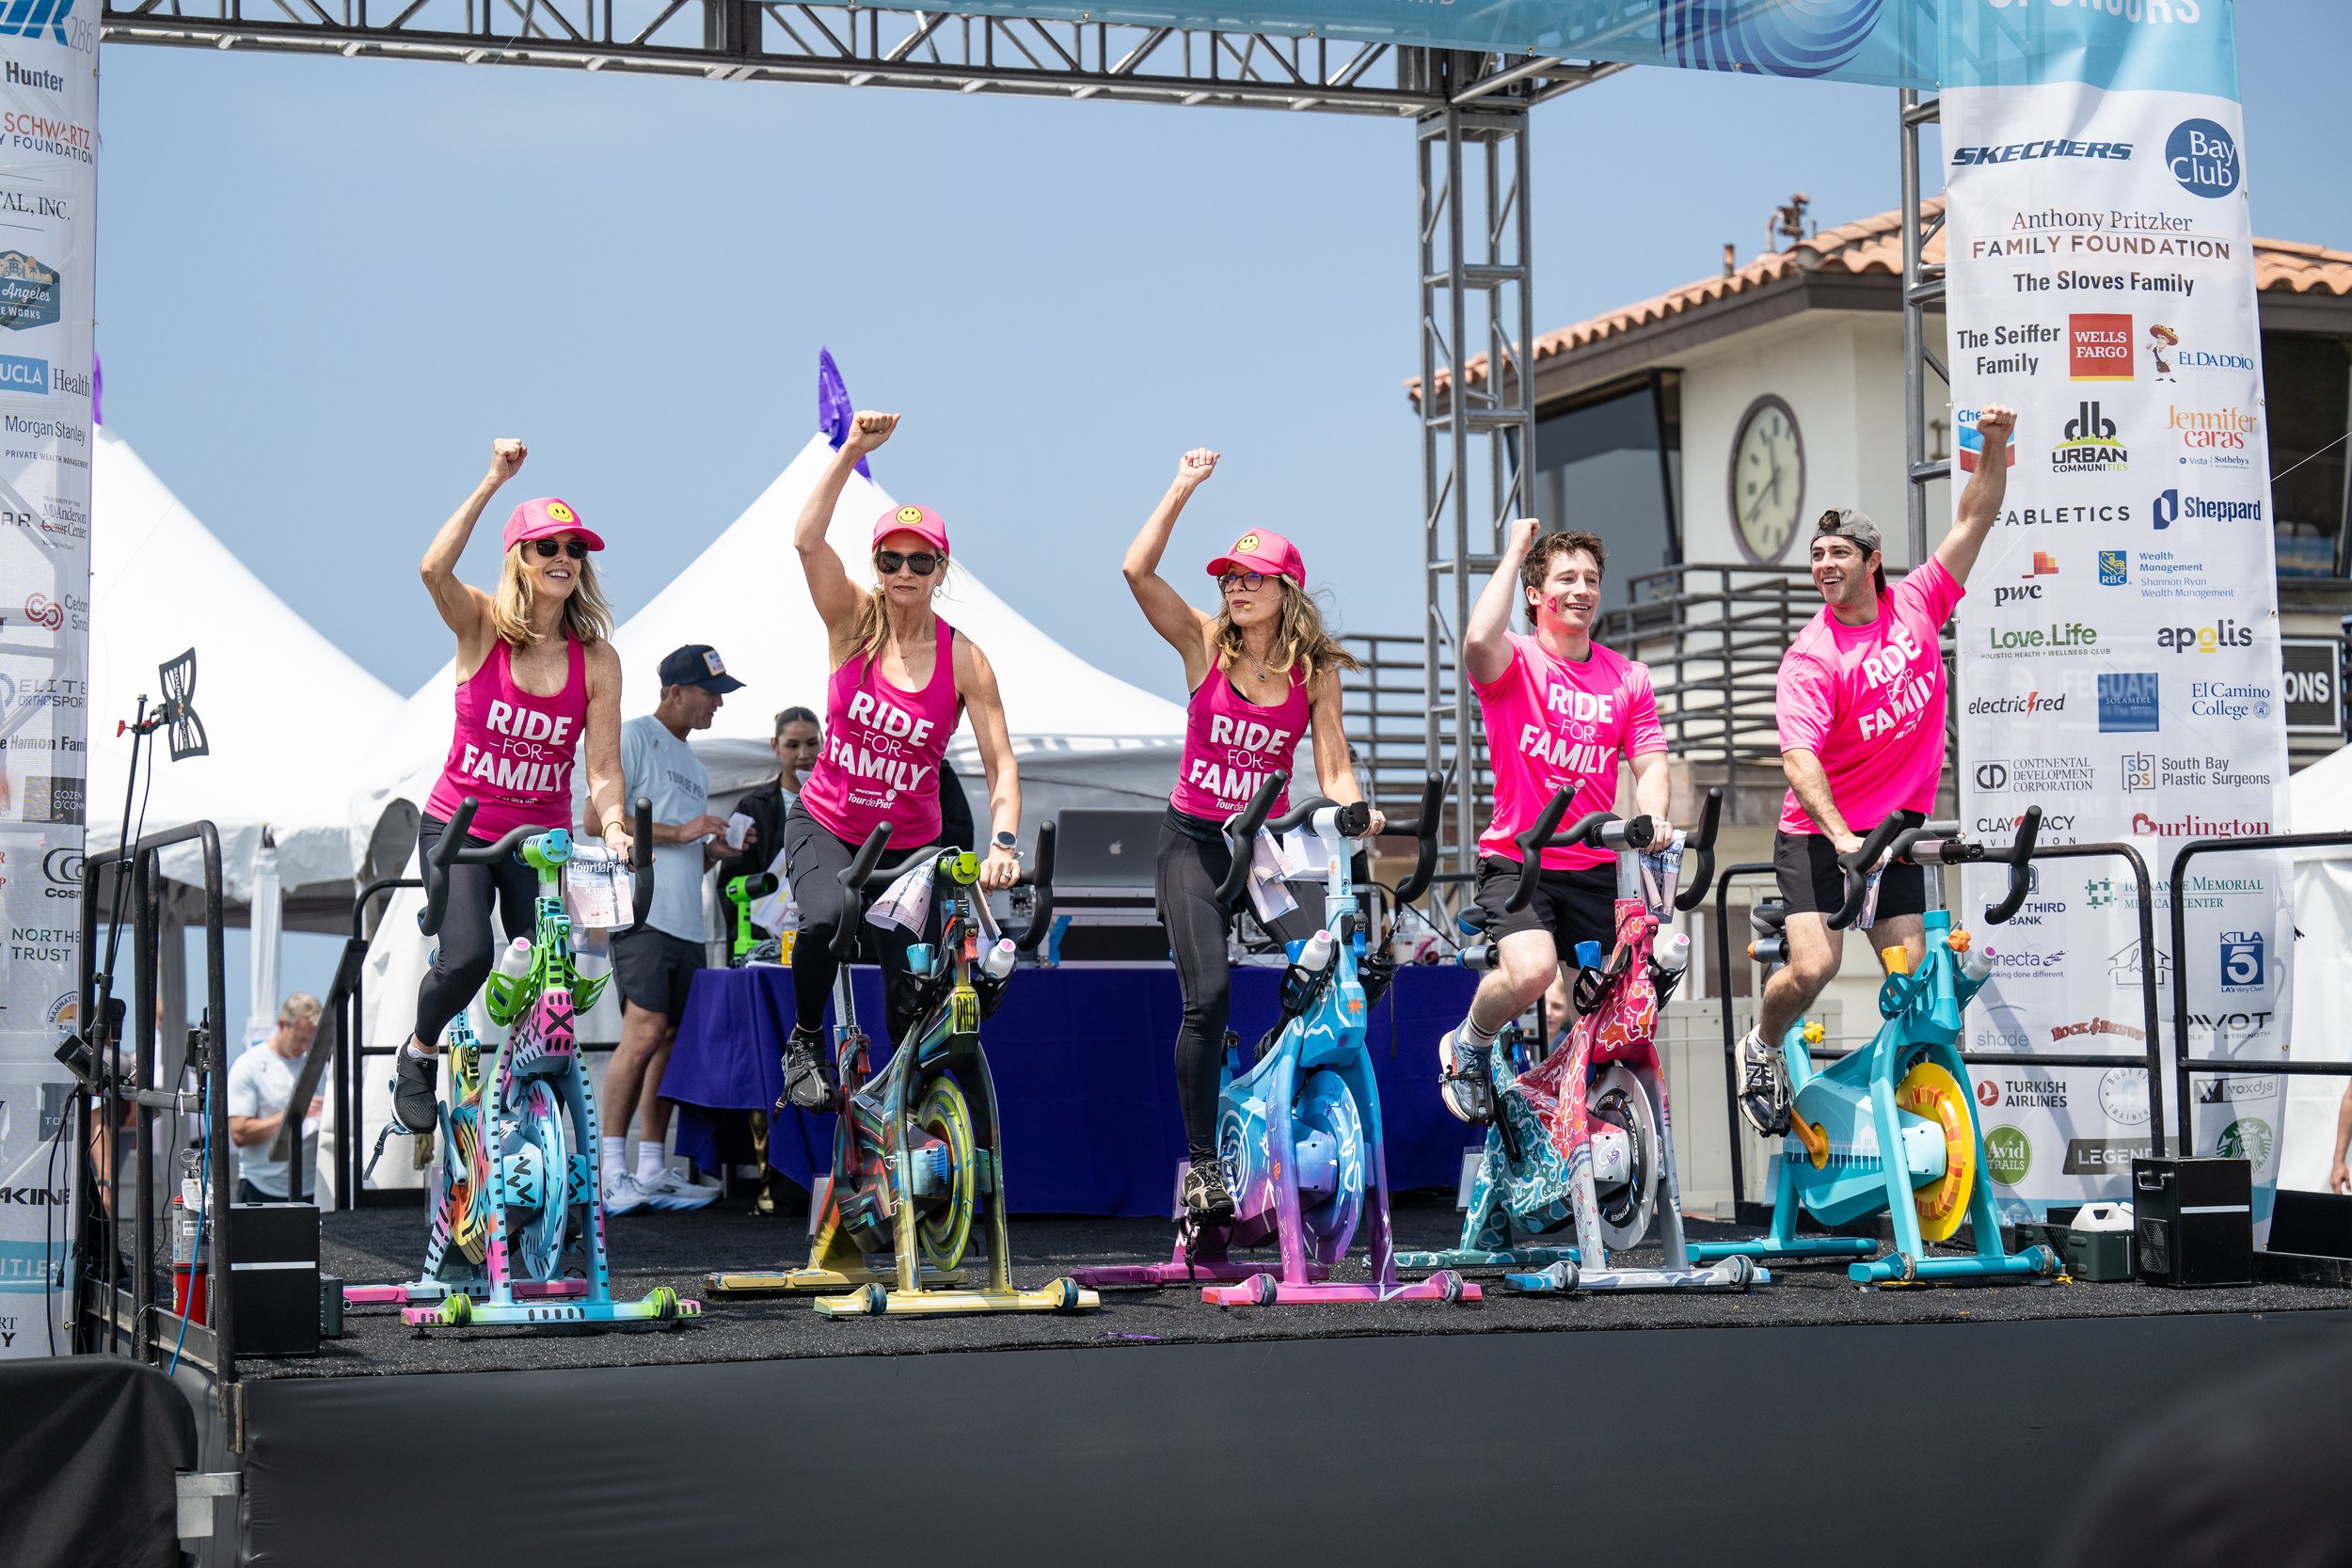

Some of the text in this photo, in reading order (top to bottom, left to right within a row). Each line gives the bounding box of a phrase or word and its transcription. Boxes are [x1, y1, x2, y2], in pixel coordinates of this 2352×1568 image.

[71, 16, 93, 55] 286
[6, 60, 63, 92] Hunter
[4, 112, 90, 150] SCHWARTZ
[13, 135, 93, 166] FOUNDATION
[1950, 138, 2133, 166] SKECHERS
[2188, 130, 2237, 167] Bay
[2169, 156, 2233, 188] Club
[38, 197, 71, 221] INC.
[2011, 208, 2193, 232] Anthony Pritzker
[1973, 234, 2230, 260] FAMILY FOUNDATION
[2, 282, 51, 303] Angeles
[2013, 270, 2194, 296] The Sloves Family
[8, 306, 40, 320] WORKS
[1957, 324, 2060, 349] The Seiffer
[2074, 331, 2127, 343] WELLS
[2076, 346, 2127, 358] FARGO
[1977, 353, 2039, 375] Family
[0, 363, 90, 398] UCLA Health
[2165, 404, 2257, 433] Jennifer
[5, 415, 86, 447] Morgan Stanley
[2184, 430, 2244, 450] caras
[6, 450, 89, 469] PRIVATE WEALTH MANAGEMENT
[2052, 447, 2128, 466] URBAN
[2052, 463, 2128, 473] COMMUNITIES
[1993, 505, 2130, 527] FABLETICS
[2185, 496, 2262, 523] Sheppard
[68, 522, 87, 540] Center
[2138, 551, 2174, 561] Wealth
[2139, 562, 2203, 574] Management
[2102, 575, 2125, 584] RBC
[2140, 577, 2207, 588] Shannon Ryan
[65, 594, 88, 612] Cedar
[1994, 584, 2042, 607] pwc
[2141, 588, 2234, 599] Wealth Management
[1990, 622, 2097, 649] Love.Life
[2157, 619, 2253, 654] apolis
[1980, 647, 2111, 660] HOLISTIC HEALTH WELLNESS CLUB
[2191, 682, 2270, 699] El Camino
[2283, 672, 2330, 704] ONS
[1548, 682, 1613, 724] RIDE
[1858, 663, 1938, 741] FAMILY
[2106, 697, 2151, 705] SOLAMERE
[2192, 700, 2249, 721] College
[486, 699, 572, 746] RIDE
[848, 689, 934, 747] RIDE
[1210, 714, 1291, 756] RIDE
[1560, 720, 1596, 743] FOR
[10, 735, 56, 751] Harmon
[502, 737, 543, 761] FOR
[863, 730, 902, 758] FOR
[1519, 723, 1617, 774] FAMILY
[461, 742, 571, 793] FAMILY
[830, 733, 932, 792] FAMILY
[1227, 749, 1264, 769] FOR
[2013, 757, 2091, 768] CONTINENTAL
[2161, 756, 2230, 772] South Bay
[1188, 758, 1287, 801] FAMI
[2013, 768, 2095, 781] DEVELOPMENT
[2162, 771, 2270, 788] Plastic Surgeons
[54, 789, 83, 800] COZEN
[2013, 780, 2093, 793] CORPORATION
[1977, 816, 2075, 832] CLAY ACY
[2132, 812, 2269, 839] Burlington
[1978, 836, 2076, 847] AVIION
[2192, 876, 2265, 891] MEMORIAL
[2026, 902, 2066, 912] THIRD
[2009, 916, 2042, 926] BANK
[12, 927, 81, 943] NORTHE
[2219, 931, 2265, 943] KTLA
[11, 946, 72, 962] TRUST
[2226, 945, 2258, 984] 5
[1990, 971, 2012, 980] anking
[2032, 970, 2064, 978] different
[2235, 987, 2249, 995] Very
[1977, 1030, 2028, 1047] shade
[2051, 1022, 2090, 1041] ROCK
[2005, 1081, 2066, 1093] TURKISH
[2228, 1080, 2274, 1095] voxdjs
[2005, 1095, 2067, 1108] AIRLINES
[2108, 1104, 2150, 1120] TRAININ
[1987, 1143, 2026, 1159] Avid
[1987, 1159, 2026, 1171] TRAILS
